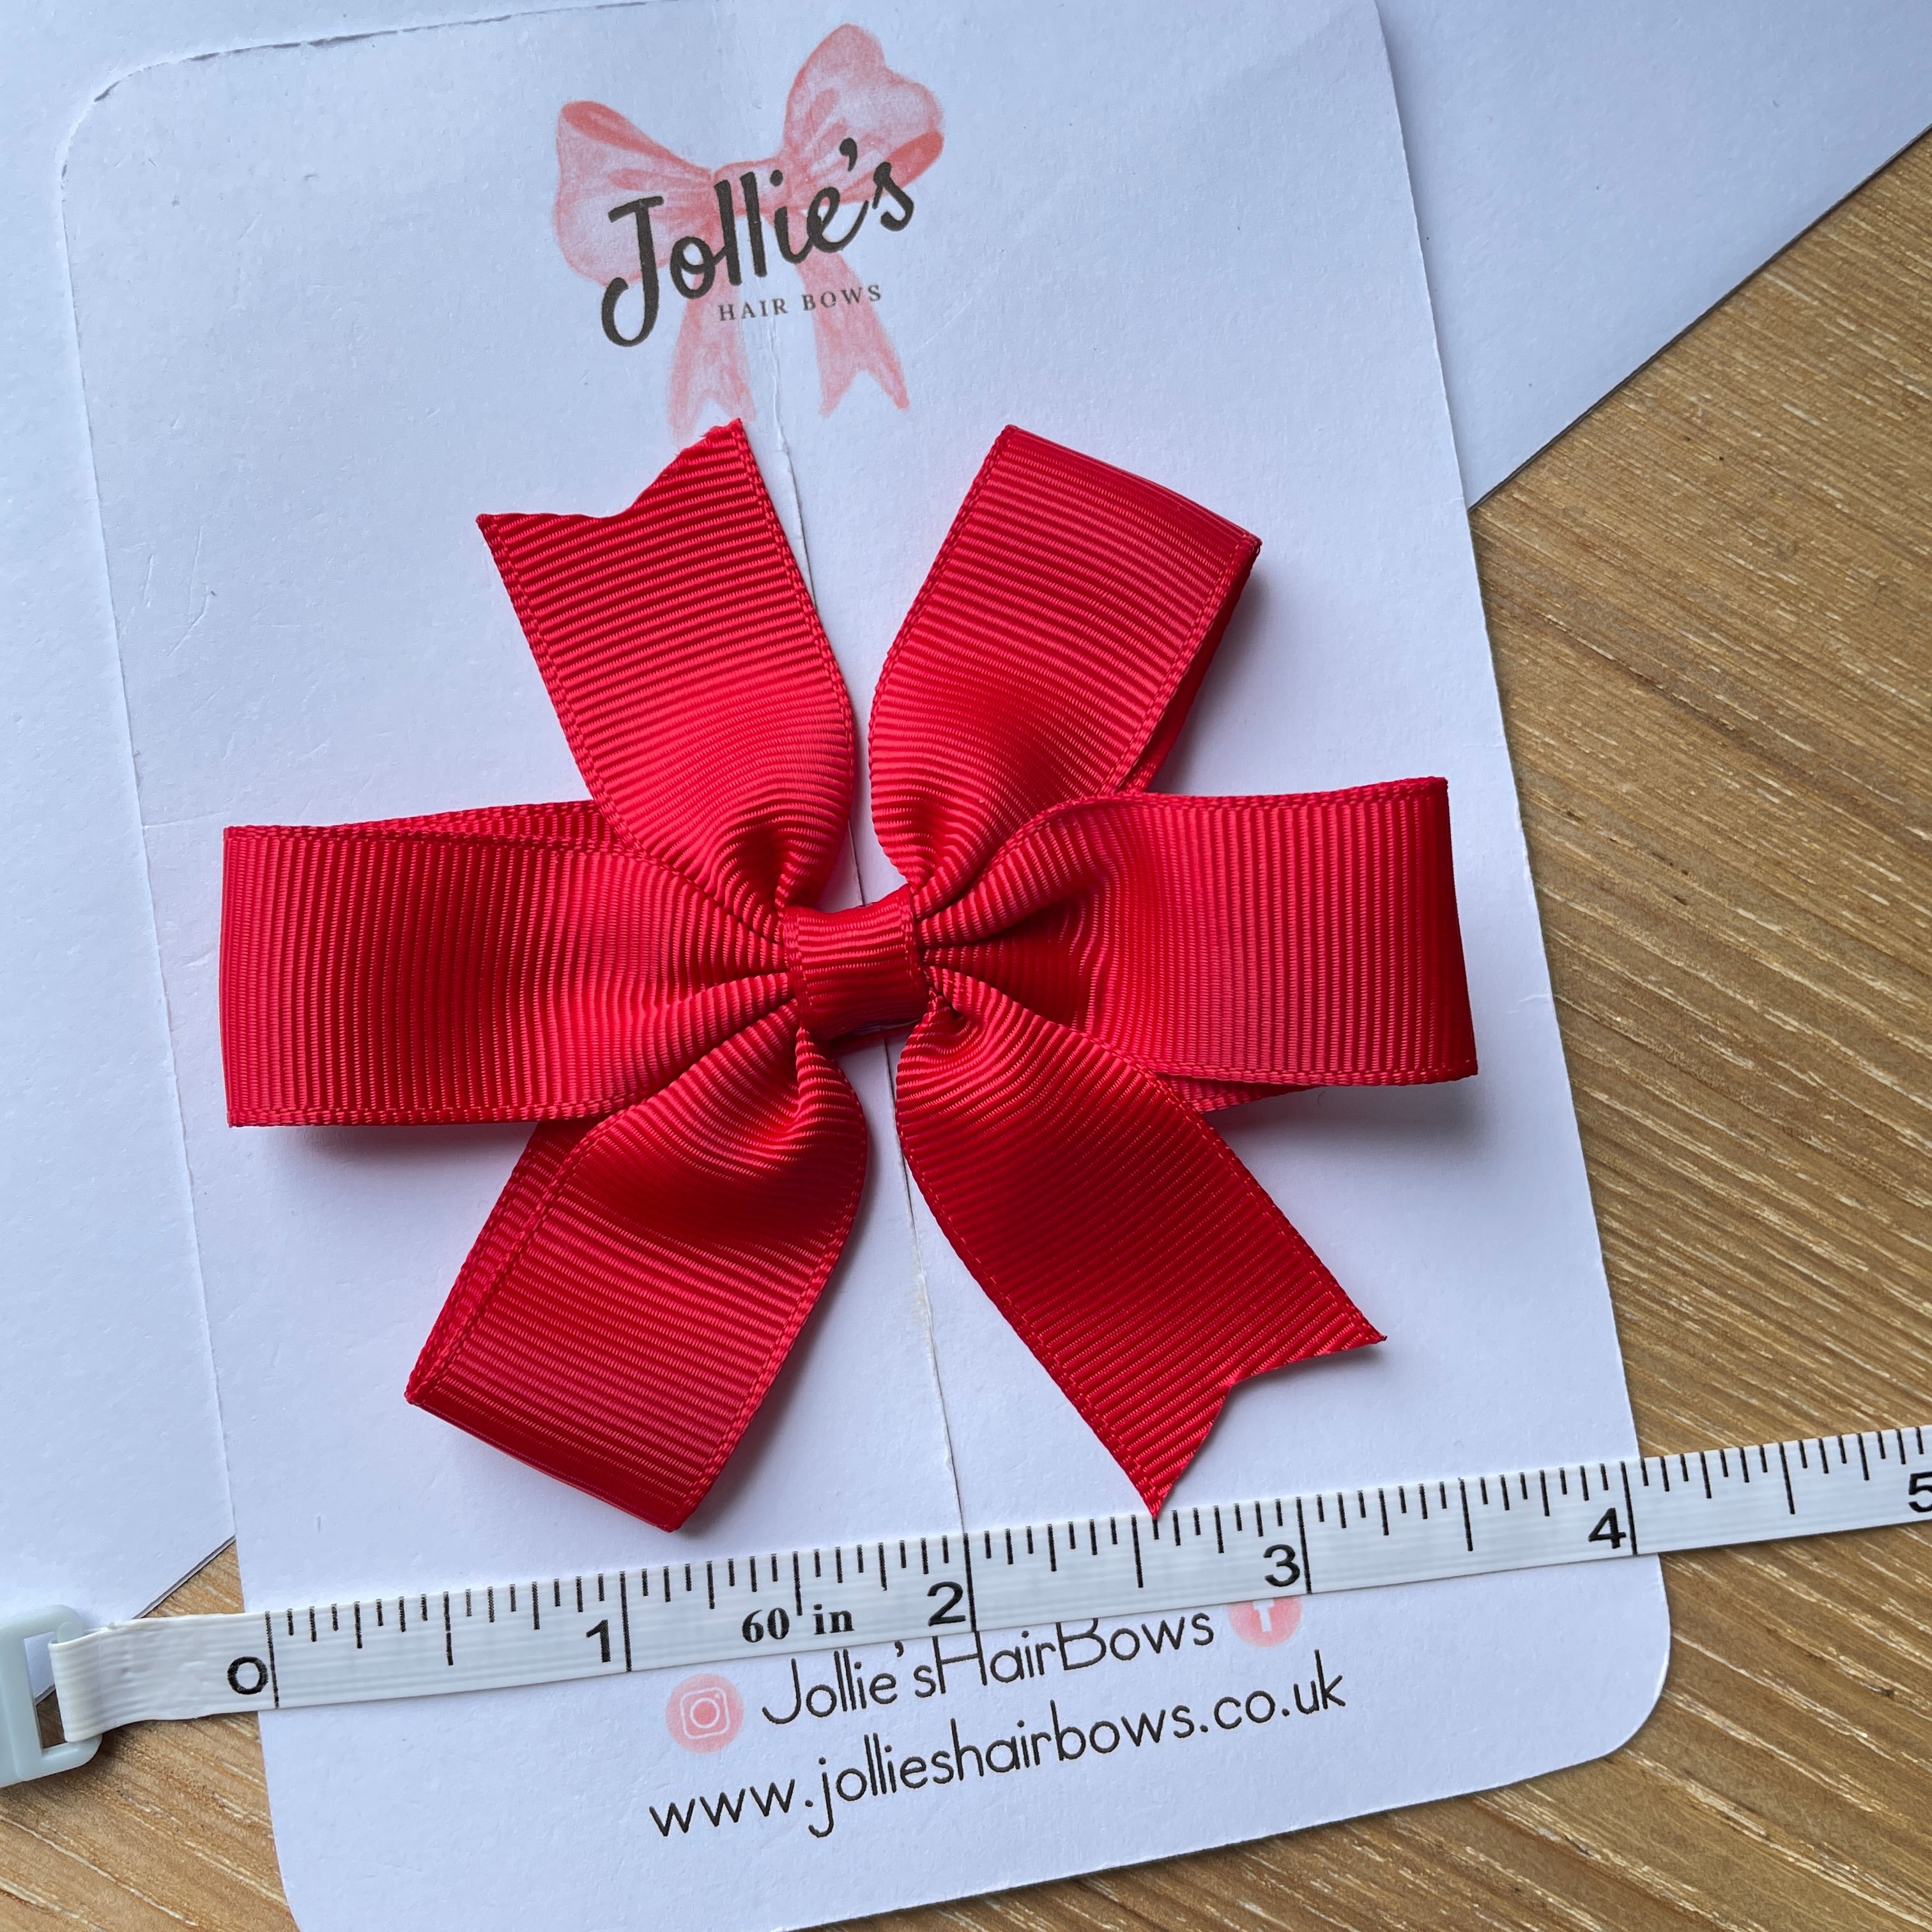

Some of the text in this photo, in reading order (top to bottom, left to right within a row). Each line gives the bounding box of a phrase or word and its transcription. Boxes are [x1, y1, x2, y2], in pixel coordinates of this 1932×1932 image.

[601, 137, 914, 347] Jollie's
[718, 284, 882, 321] HAIR BOWS
[1907, 1471, 1932, 1513] 5
[1588, 1507, 1627, 1549] 4
[1262, 1544, 1301, 1588] 3
[741, 1604, 855, 1643] 60 in
[926, 1581, 967, 1627] 2
[585, 1619, 611, 1663] 1
[226, 1655, 269, 1696] 0
[762, 1612, 1215, 1724] Jollie'sHairBows
[648, 1648, 1346, 1838] www.jollieshairbows.co.uk
